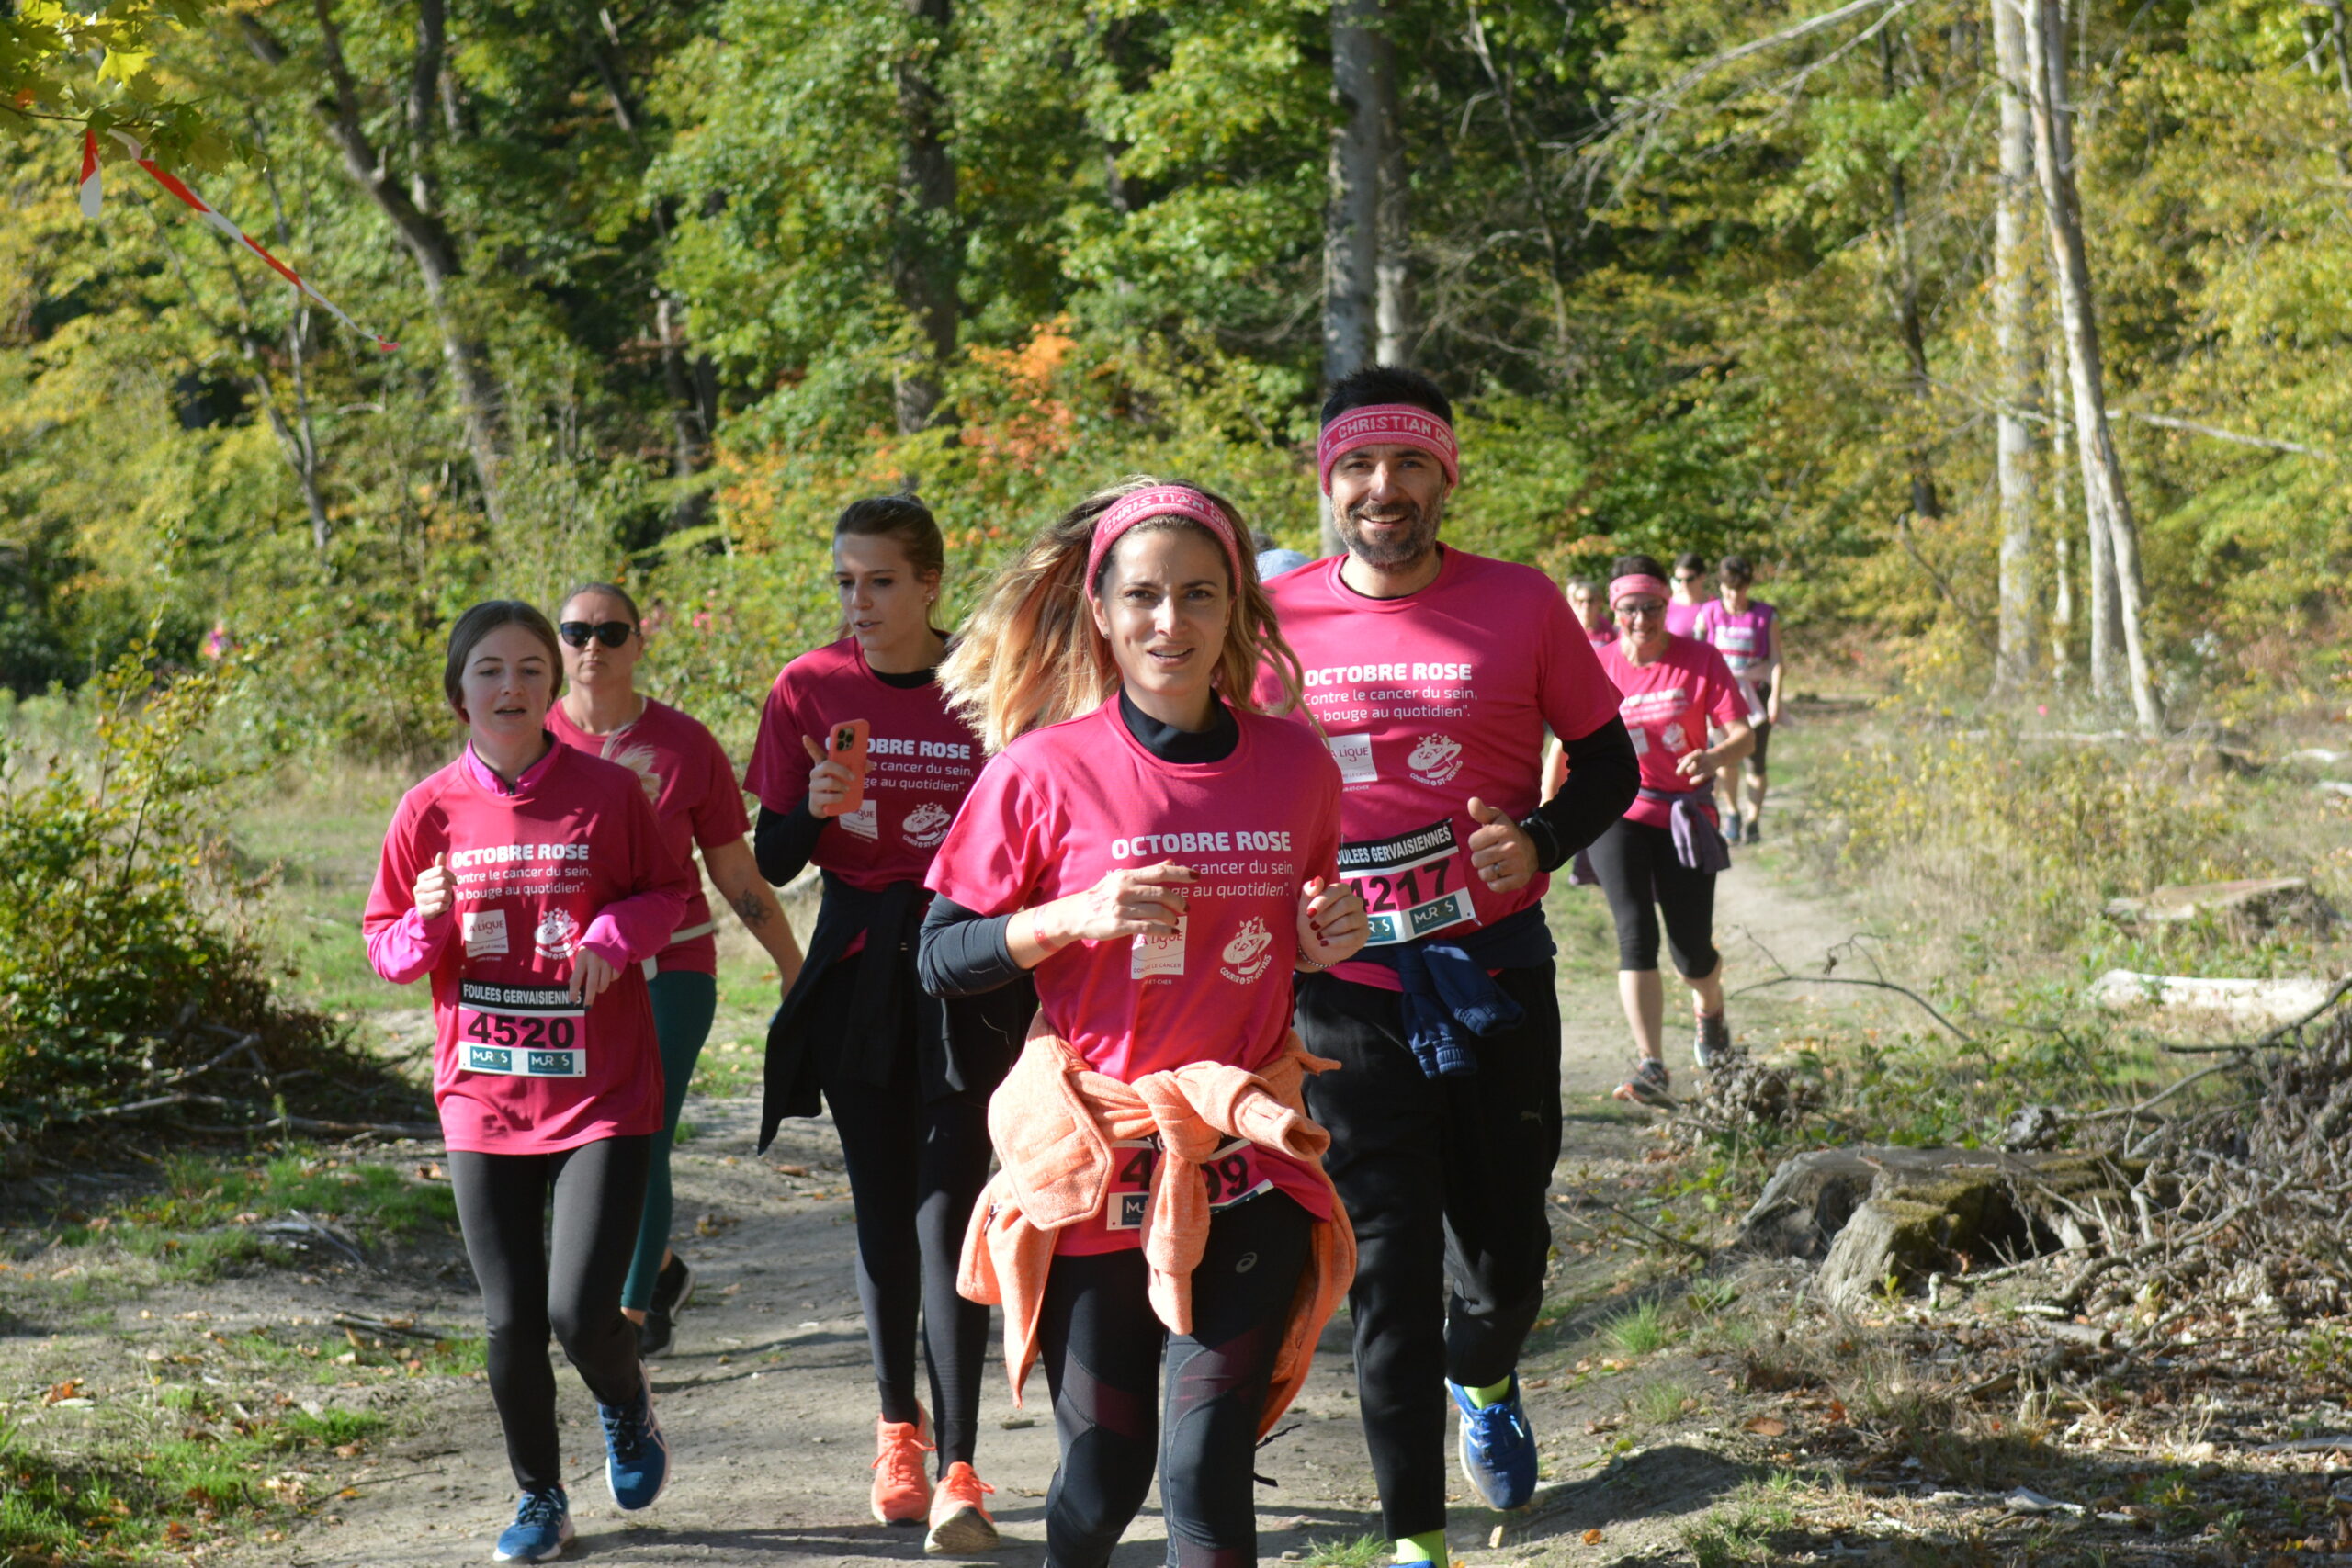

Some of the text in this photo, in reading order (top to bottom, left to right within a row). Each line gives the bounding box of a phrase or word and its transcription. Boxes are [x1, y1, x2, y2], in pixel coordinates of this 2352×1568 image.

[1339, 416, 1431, 439] CHRISTIAN
[1104, 494, 1204, 534] CHRISTIAN
[1304, 663, 1472, 687] OCTOBRE ROSE
[1352, 688, 1366, 702] le
[1370, 688, 1418, 701] cancer
[1421, 686, 1440, 699] du
[1443, 687, 1477, 701] sein,
[1323, 709, 1367, 723] bouge
[1372, 707, 1389, 718] au
[919, 740, 971, 760] ROSE
[880, 761, 922, 773] cancer
[926, 761, 942, 773] du
[944, 764, 974, 778] sein,
[880, 778, 897, 787] au
[1111, 831, 1292, 860] OCTOBRE ROSE
[1371, 826, 1452, 863] GERVAISIENNES
[451, 843, 589, 869] OCTOBRE ROSE
[454, 865, 593, 886] ontre le cancer du sein,
[1250, 860, 1268, 874] du
[1271, 860, 1295, 876] sein,
[465, 887, 503, 900] bouge
[504, 886, 520, 895] au
[1193, 885, 1213, 897] au
[1351, 858, 1451, 913] 4217
[463, 983, 582, 1005] FOULEES GERVAISIENNS
[467, 1012, 575, 1049] 4520
